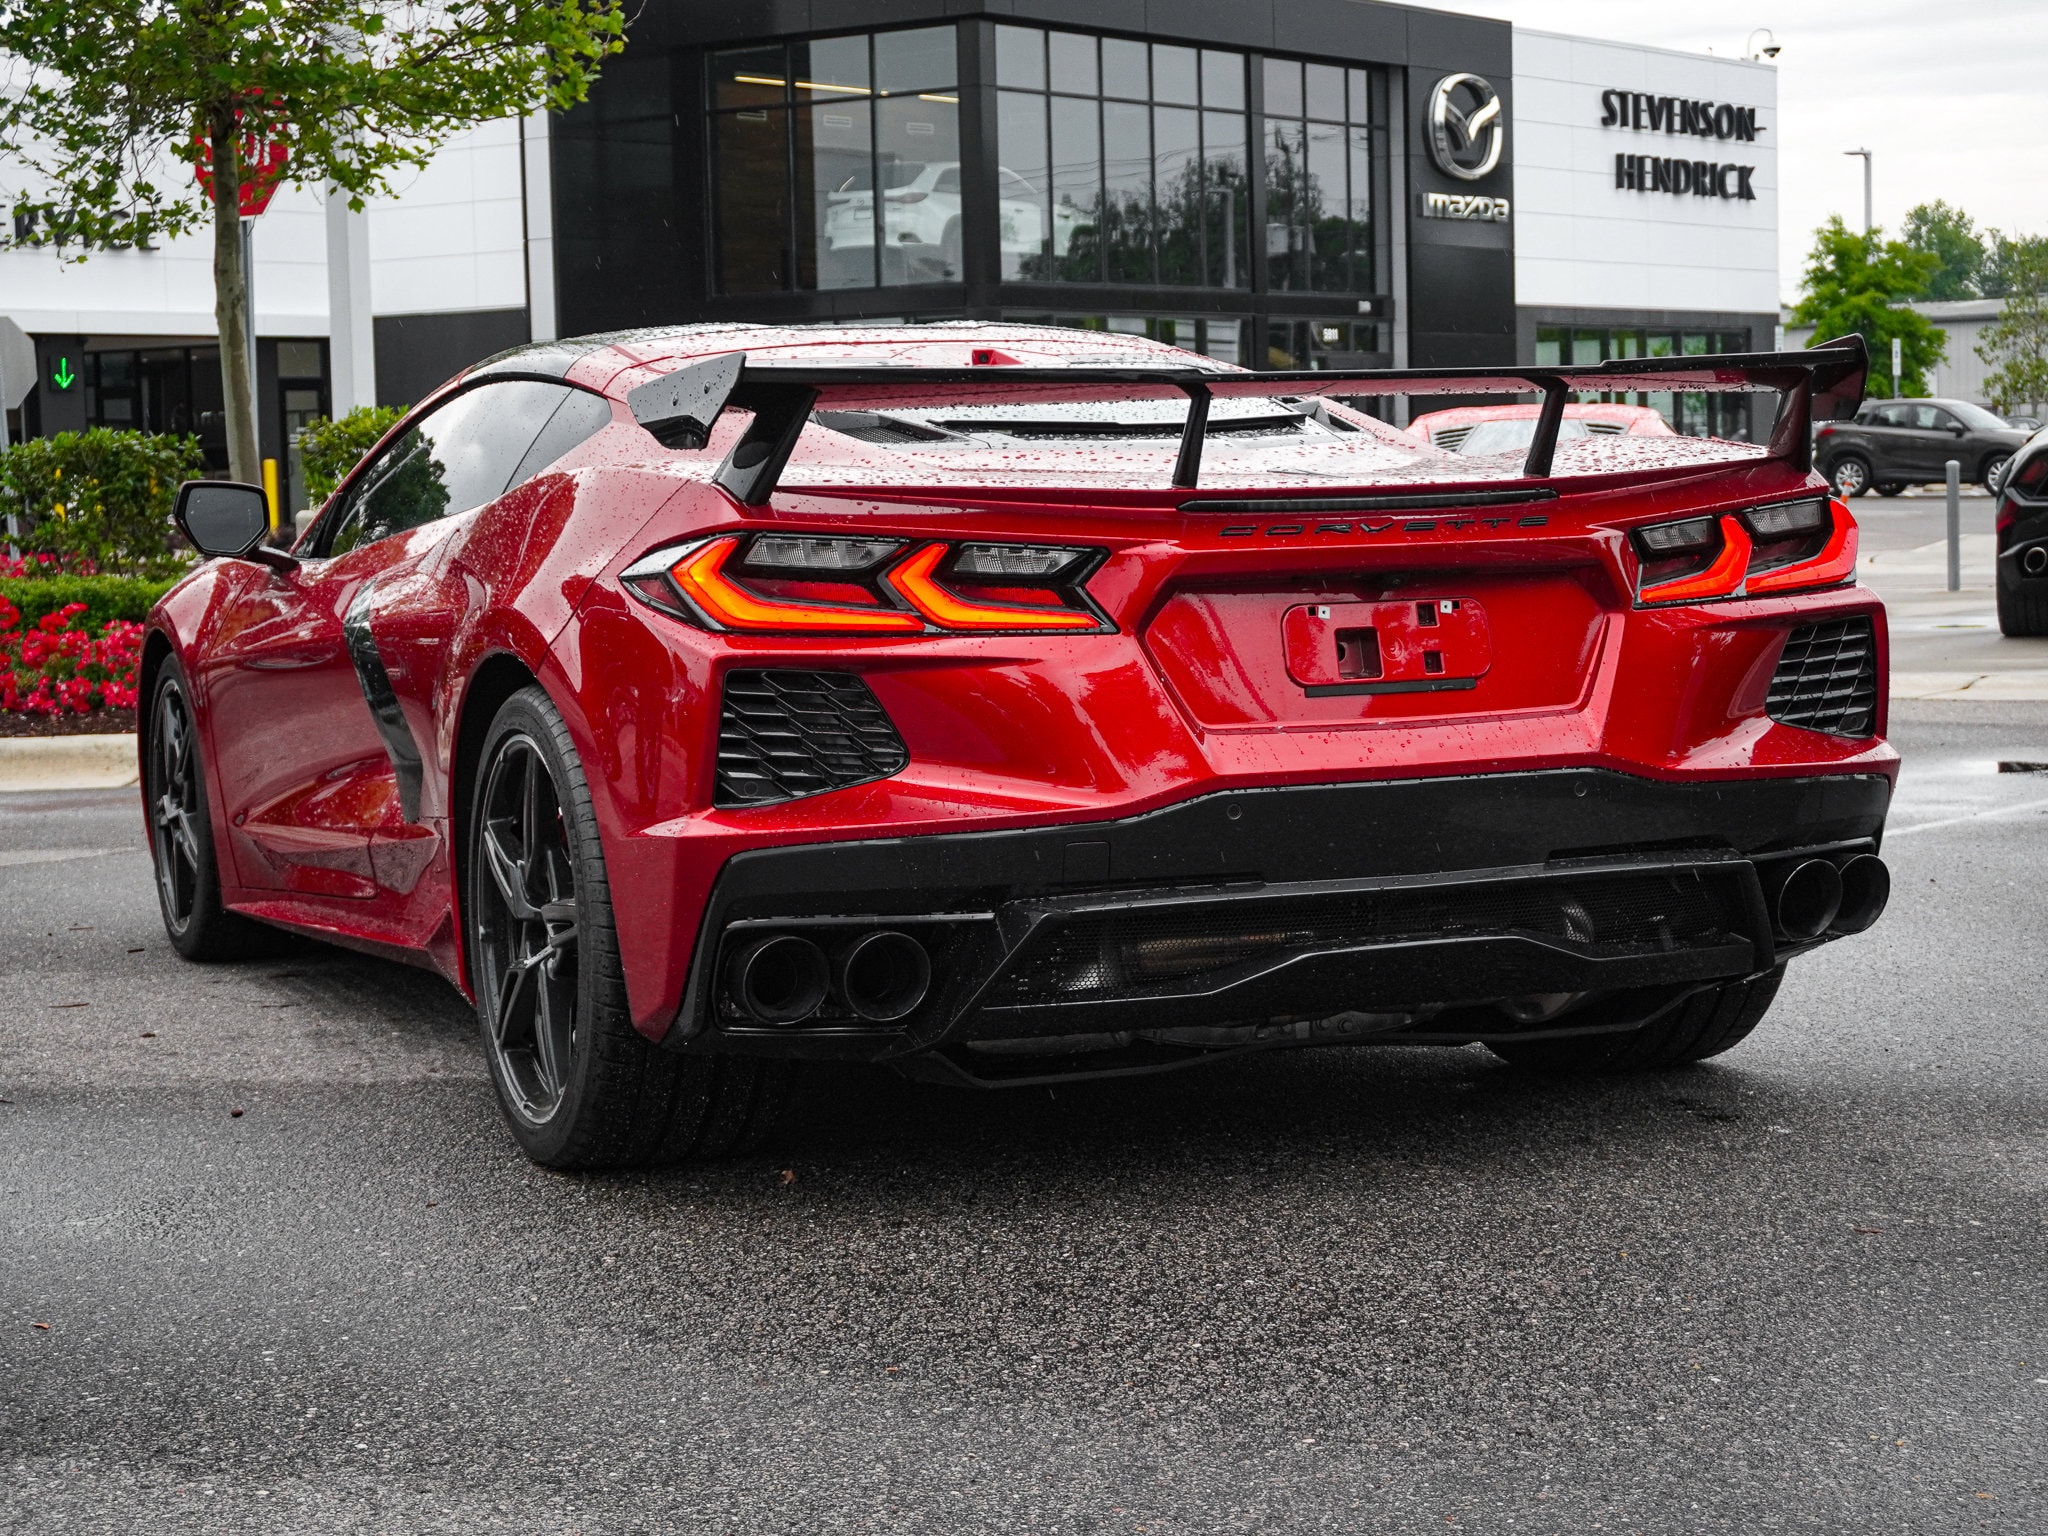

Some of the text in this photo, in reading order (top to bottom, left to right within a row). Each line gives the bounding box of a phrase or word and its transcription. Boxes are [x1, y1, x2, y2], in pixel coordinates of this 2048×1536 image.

[1601, 89, 1767, 141] STEVENSON-
[1615, 153, 1757, 200] HENDRICK
[1218, 515, 1549, 537] CORVETTE
